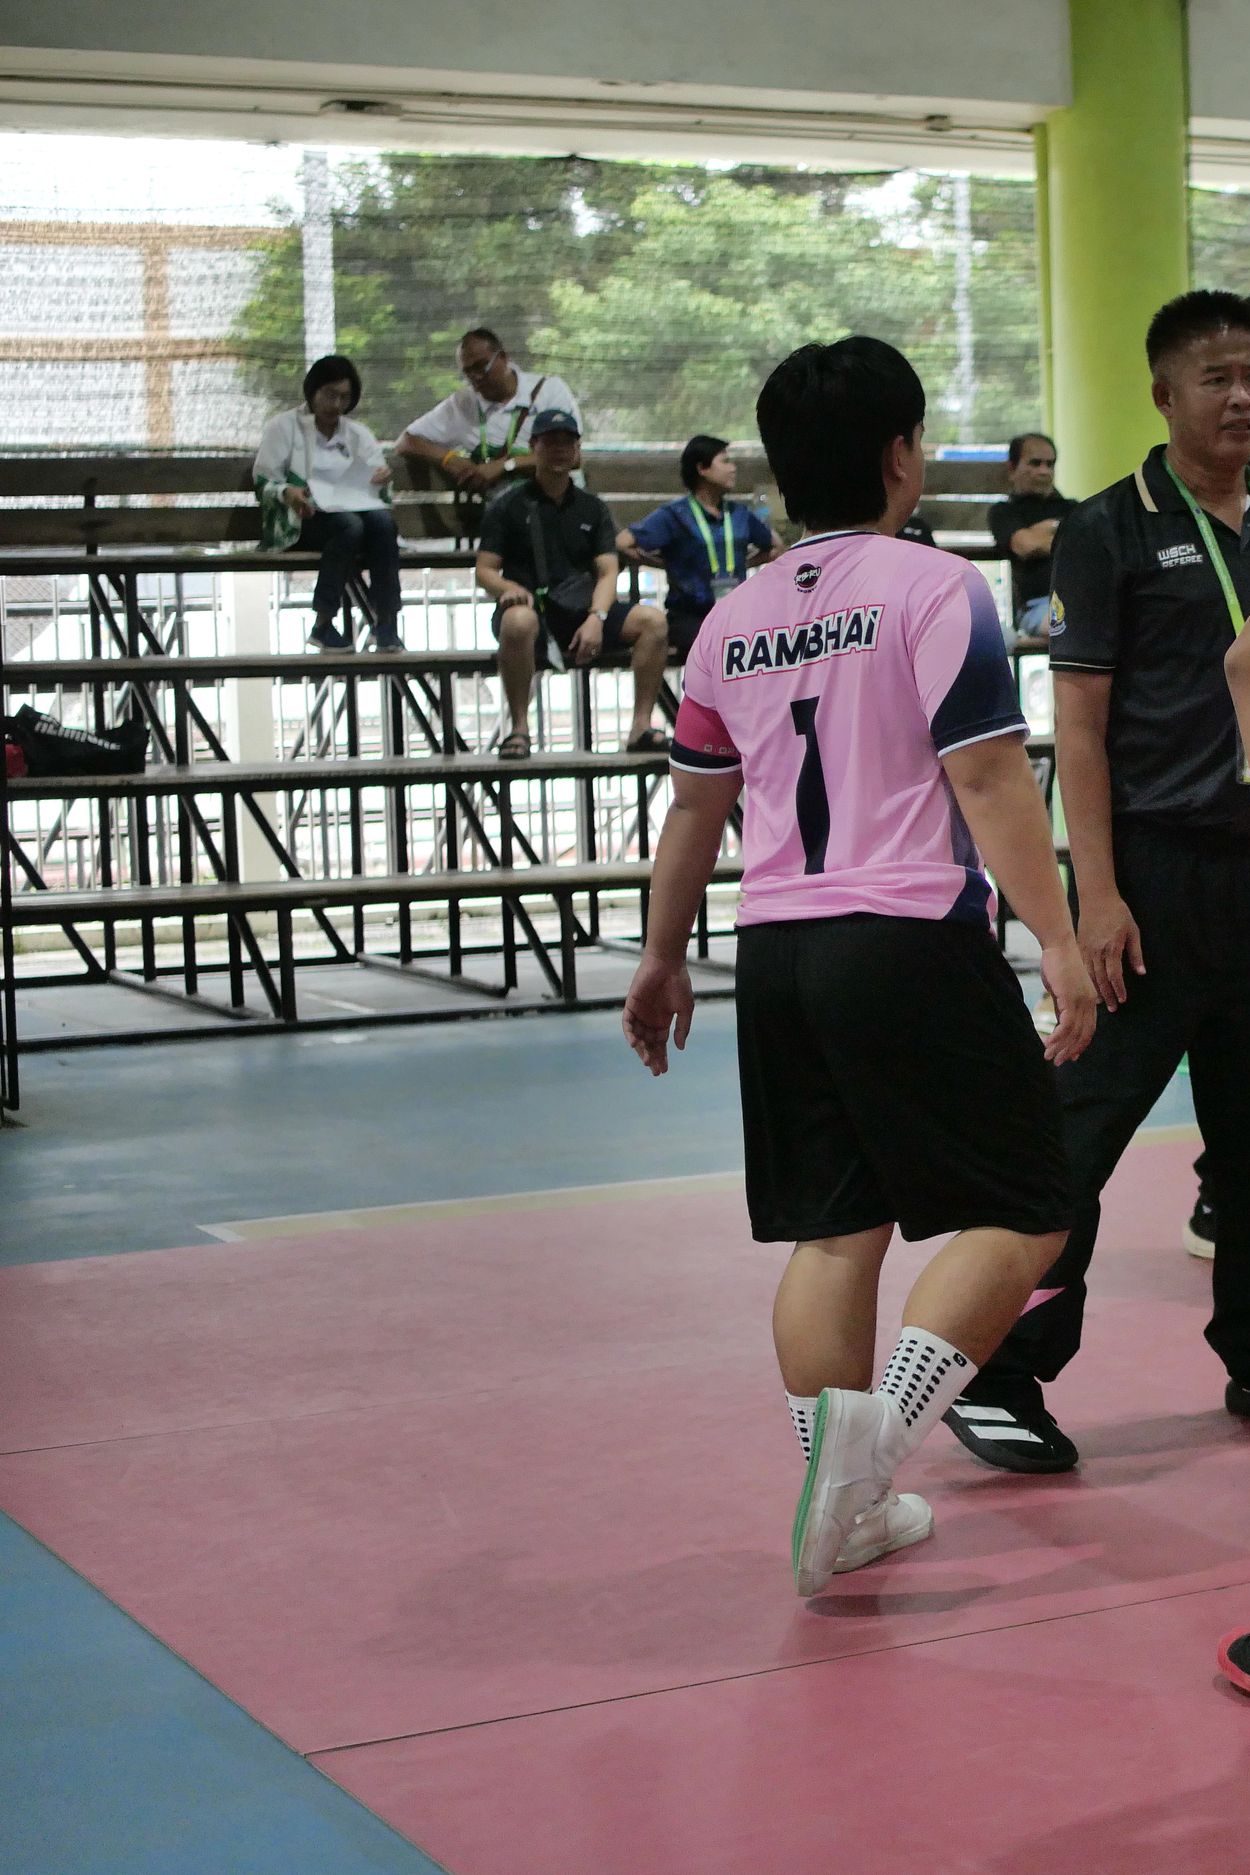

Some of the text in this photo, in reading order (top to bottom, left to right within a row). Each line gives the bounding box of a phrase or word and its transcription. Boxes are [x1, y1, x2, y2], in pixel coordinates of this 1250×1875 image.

[1158, 544, 1197, 561] WSCH
[1162, 554, 1203, 568] REFEREE
[724, 607, 882, 679] RAMBHAI
[790, 695, 830, 875] 1
